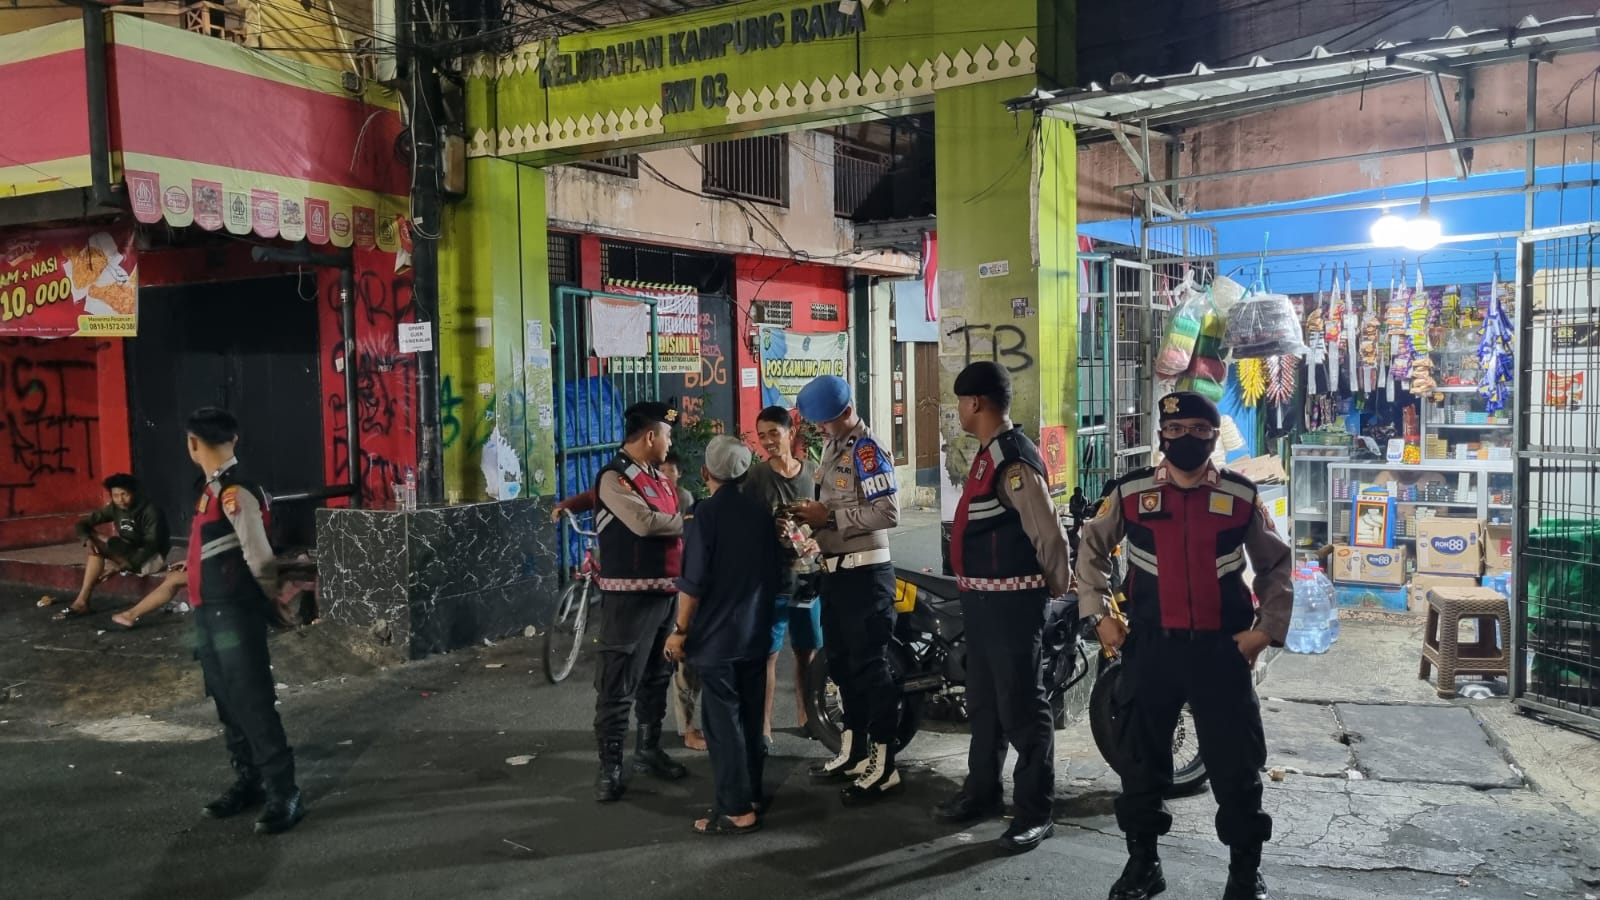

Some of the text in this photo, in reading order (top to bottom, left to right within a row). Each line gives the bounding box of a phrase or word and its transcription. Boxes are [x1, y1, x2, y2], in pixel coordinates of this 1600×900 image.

[668, 12, 785, 66] KAMPUNG
[791, 2, 866, 44] RAWA
[661, 73, 729, 115] RW 03
[31, 256, 58, 279] NASI
[1, 277, 71, 321] 10.000
[766, 359, 844, 377] POS KAMLING RW 03
